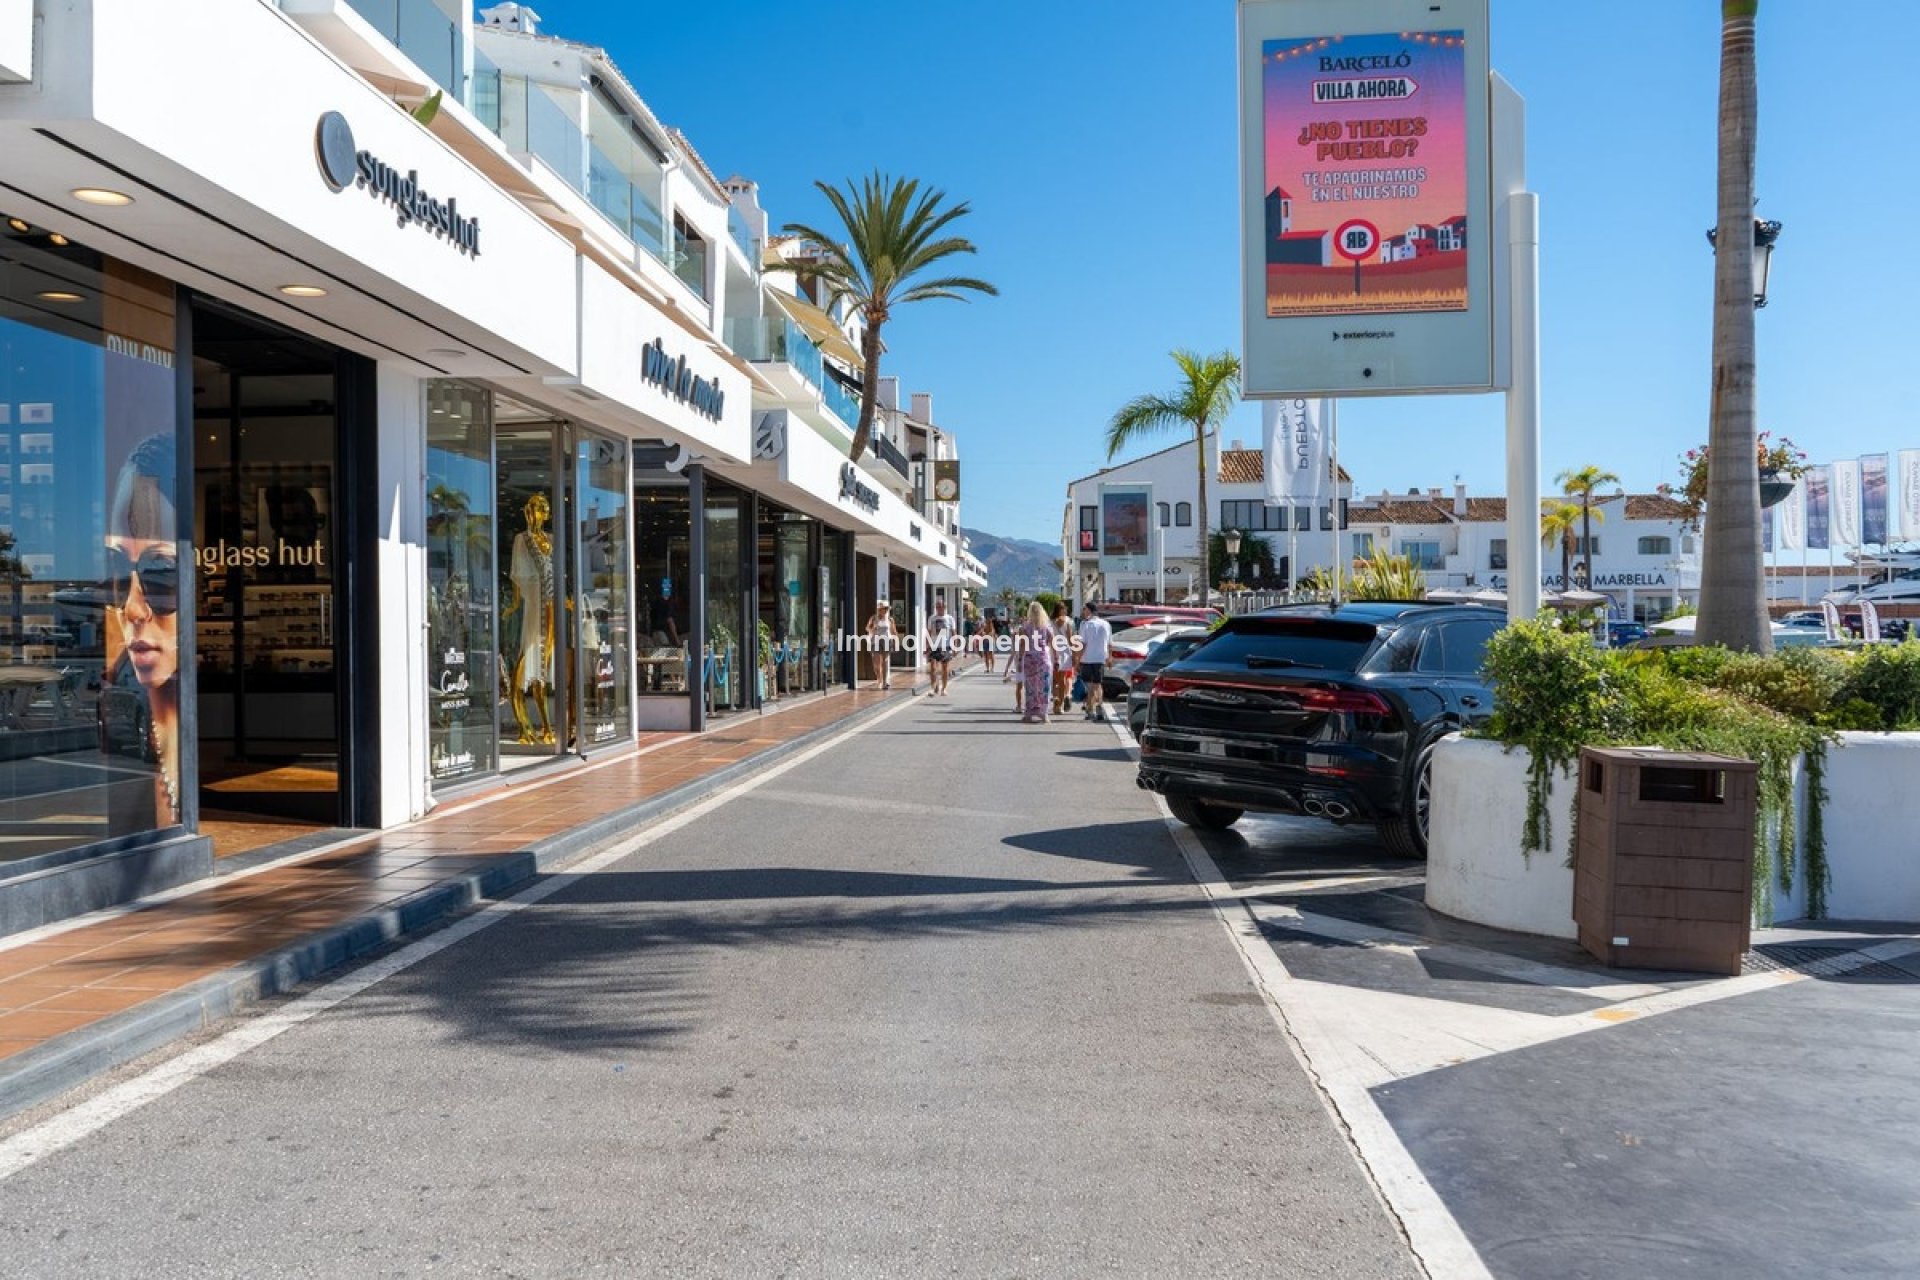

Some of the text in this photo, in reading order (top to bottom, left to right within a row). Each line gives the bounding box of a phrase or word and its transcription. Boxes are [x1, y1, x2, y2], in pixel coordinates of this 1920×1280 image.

[1319, 50, 1411, 72] BARCELÓ
[1316, 79, 1407, 100] VILLA AHORA
[1298, 117, 1427, 146] ¿NO TIENES
[1317, 138, 1419, 161] PUEBLO?
[1303, 167, 1426, 187] TE APADRINAMOS
[1311, 183, 1419, 202] EN EL NUESTRO
[279, 537, 325, 566] hut
[1594, 573, 1665, 586] MARBELLA
